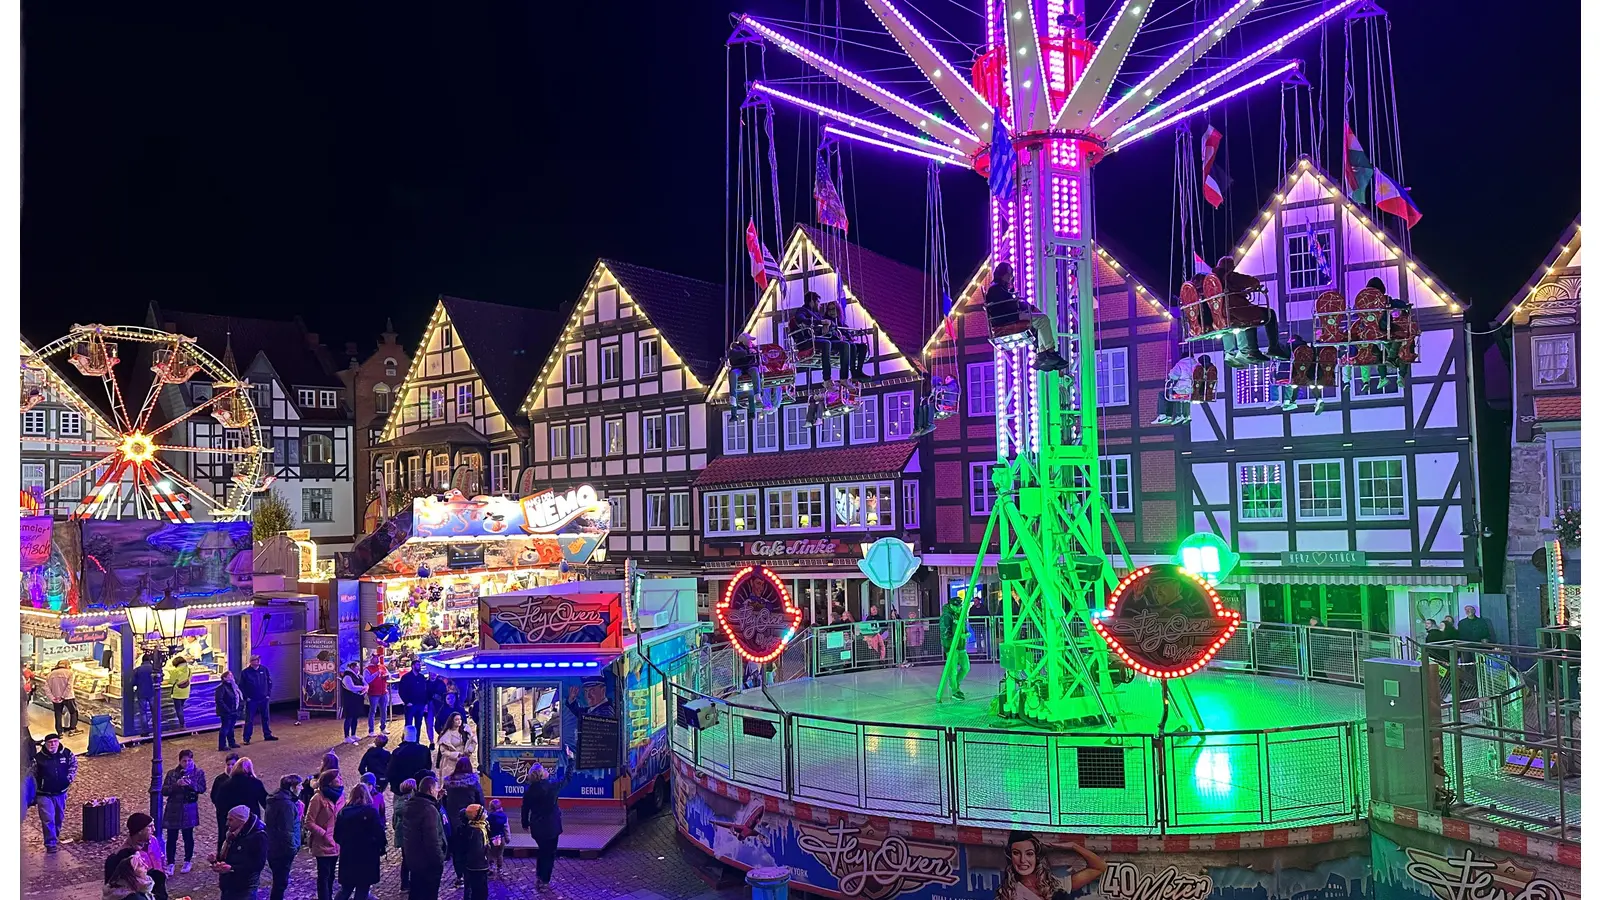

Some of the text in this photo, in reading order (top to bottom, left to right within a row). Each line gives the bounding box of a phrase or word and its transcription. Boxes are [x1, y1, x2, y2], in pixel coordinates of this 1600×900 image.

[523, 484, 597, 528] NEMO
[497, 596, 549, 642] Fly
[1112, 609, 1164, 652] Fly
[1163, 644, 1176, 658] 40
[305, 662, 335, 672] NEMO
[501, 759, 528, 784] Fly
[504, 786, 525, 794] TOKYO
[581, 786, 604, 795] BERLIN
[799, 819, 952, 896] Fly Over
[1103, 864, 1208, 900] 40 Meter
